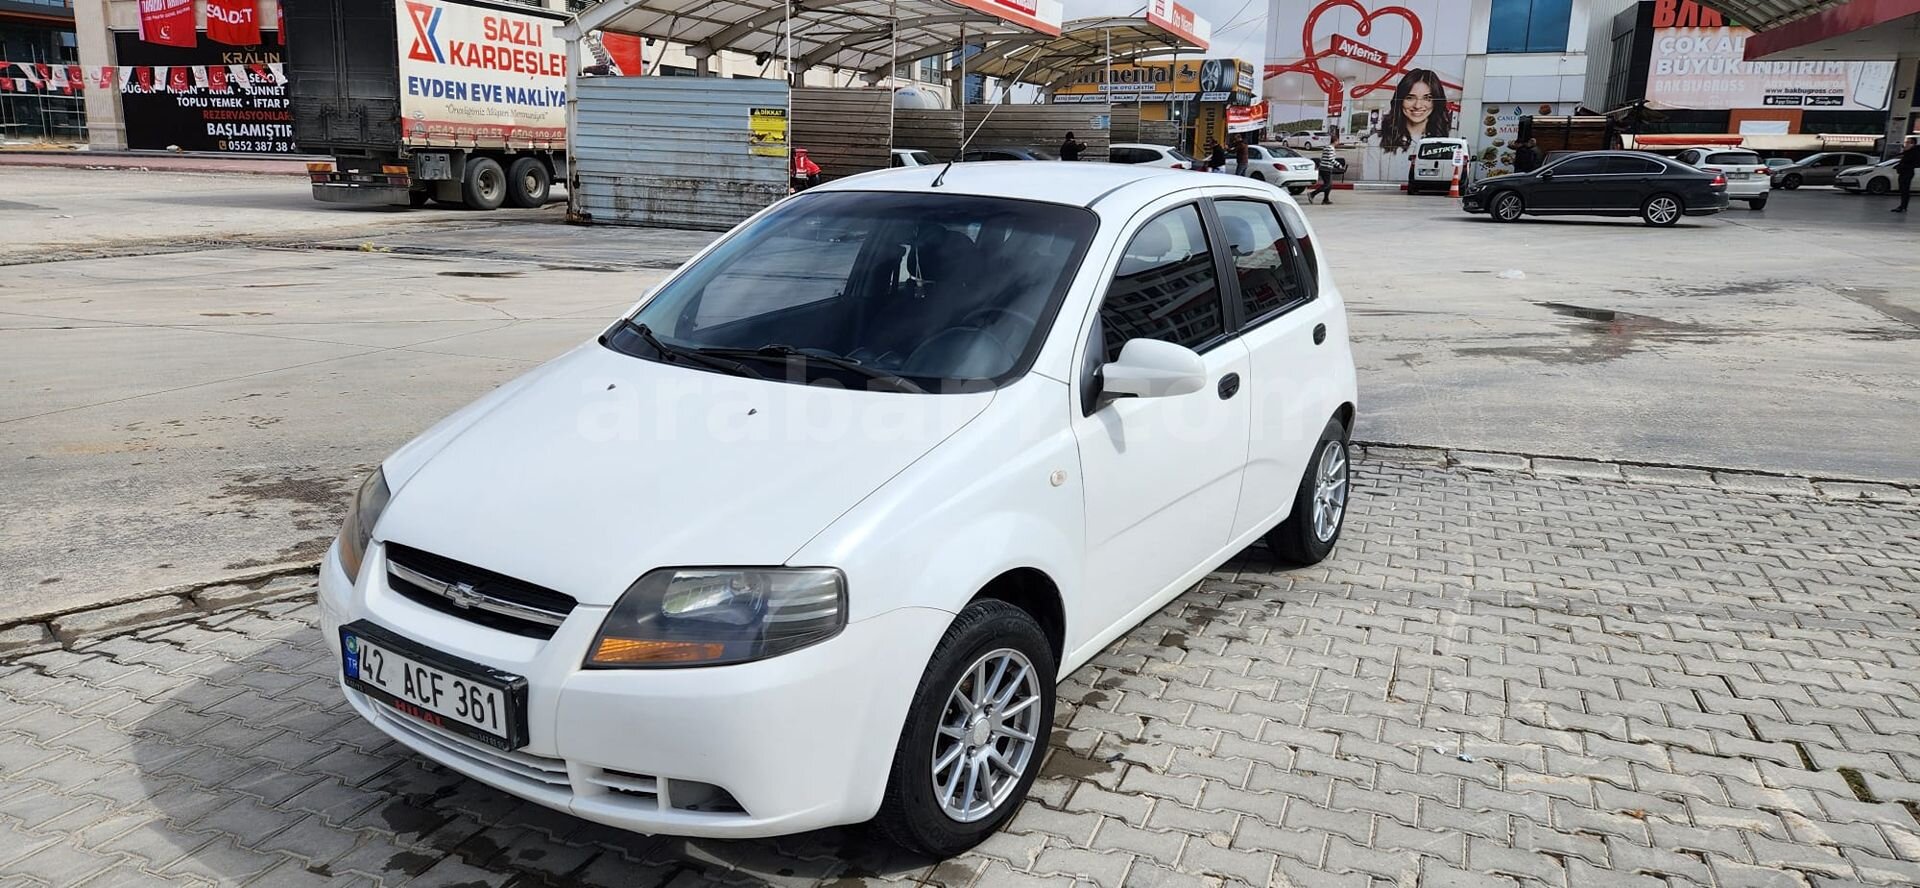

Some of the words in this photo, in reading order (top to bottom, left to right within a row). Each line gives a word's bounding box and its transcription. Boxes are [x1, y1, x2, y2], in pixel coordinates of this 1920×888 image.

[483, 16, 542, 47] SAZLI
[1339, 39, 1383, 63] Aytemiz
[1659, 36, 1712, 56] ÇOK
[1656, 55, 1741, 76] BÜYÜK
[249, 73, 276, 83] SEZO
[245, 83, 285, 95] SÜNNET
[408, 76, 467, 101] EVDEN
[471, 83, 503, 103] EVE
[176, 97, 208, 107] TOPLU
[210, 98, 242, 108] YEMEK
[254, 96, 280, 108] İFTAR
[228, 141, 252, 151] 0552
[255, 141, 272, 151] 387
[275, 142, 288, 152] 38
[347, 657, 358, 670] TR
[361, 645, 387, 687] 42
[404, 663, 444, 708] ACF
[453, 681, 498, 730] 361
